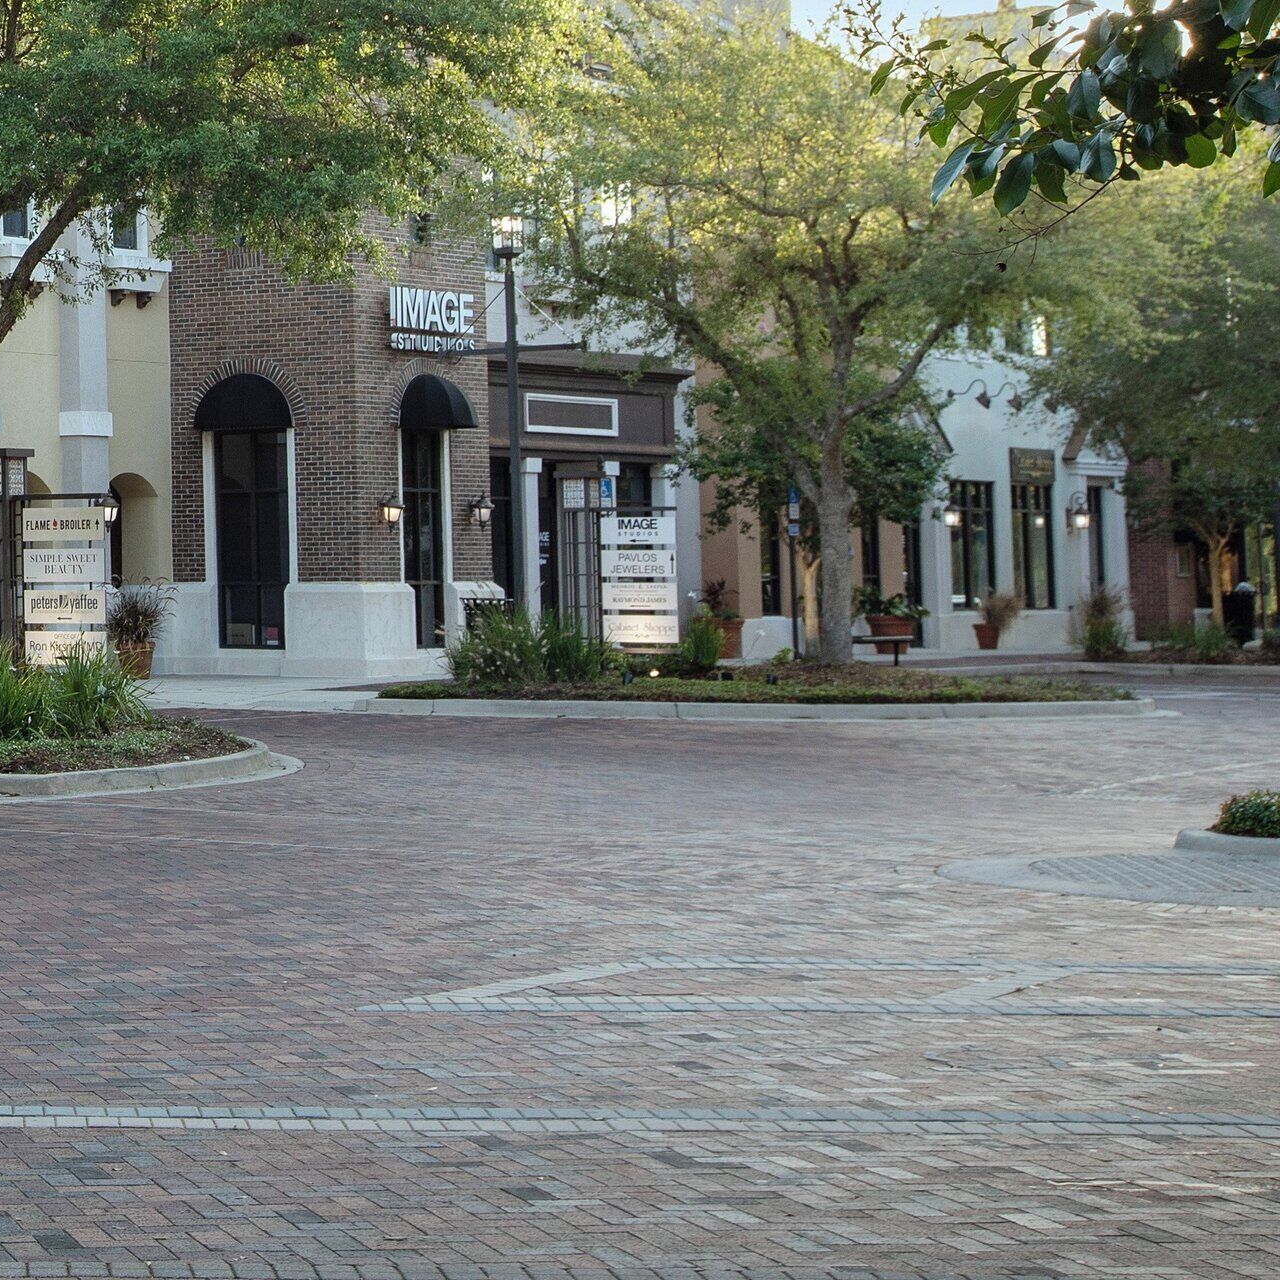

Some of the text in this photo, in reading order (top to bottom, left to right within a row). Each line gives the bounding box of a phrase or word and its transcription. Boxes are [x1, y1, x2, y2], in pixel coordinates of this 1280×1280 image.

[390, 286, 475, 334] IMAGE
[26, 519, 91, 531] FLAME BROILER
[617, 518, 658, 530] IMAGE
[29, 553, 97, 563] SIMPLE SWEET
[618, 553, 658, 563] PAVLOS
[44, 564, 85, 575] BEAUTY
[610, 564, 665, 574] JEWELERS
[31, 594, 98, 613] peters yaffee
[29, 640, 48, 651] Ron
